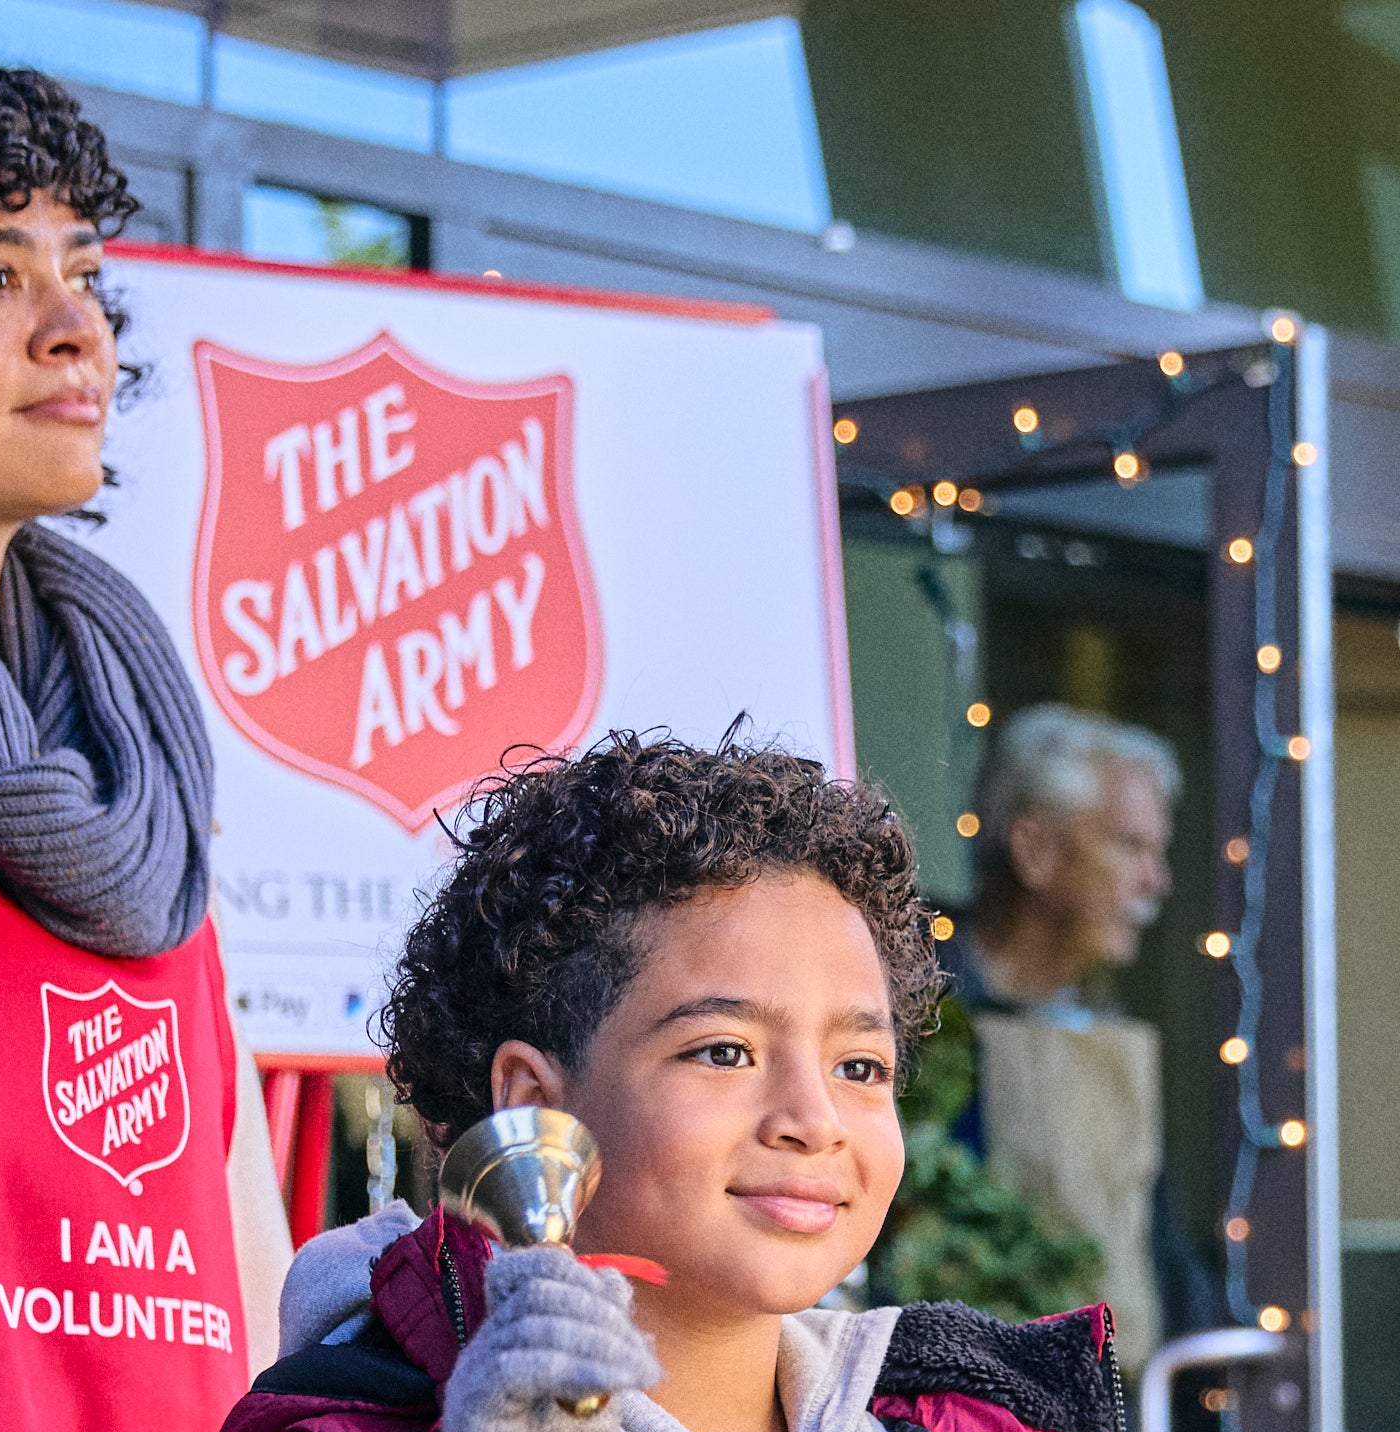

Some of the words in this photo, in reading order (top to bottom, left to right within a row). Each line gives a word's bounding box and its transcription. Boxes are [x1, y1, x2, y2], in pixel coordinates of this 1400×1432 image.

[264, 383, 417, 531] THE
[220, 416, 550, 697] SALVATION
[350, 552, 544, 769] ARMY
[55, 1019, 169, 1126] SALVATION
[67, 1004, 123, 1064] THE
[102, 1073, 169, 1156] ARMY
[60, 1217, 71, 1263] I
[85, 1220, 155, 1270] AM
[165, 1228, 197, 1275] A
